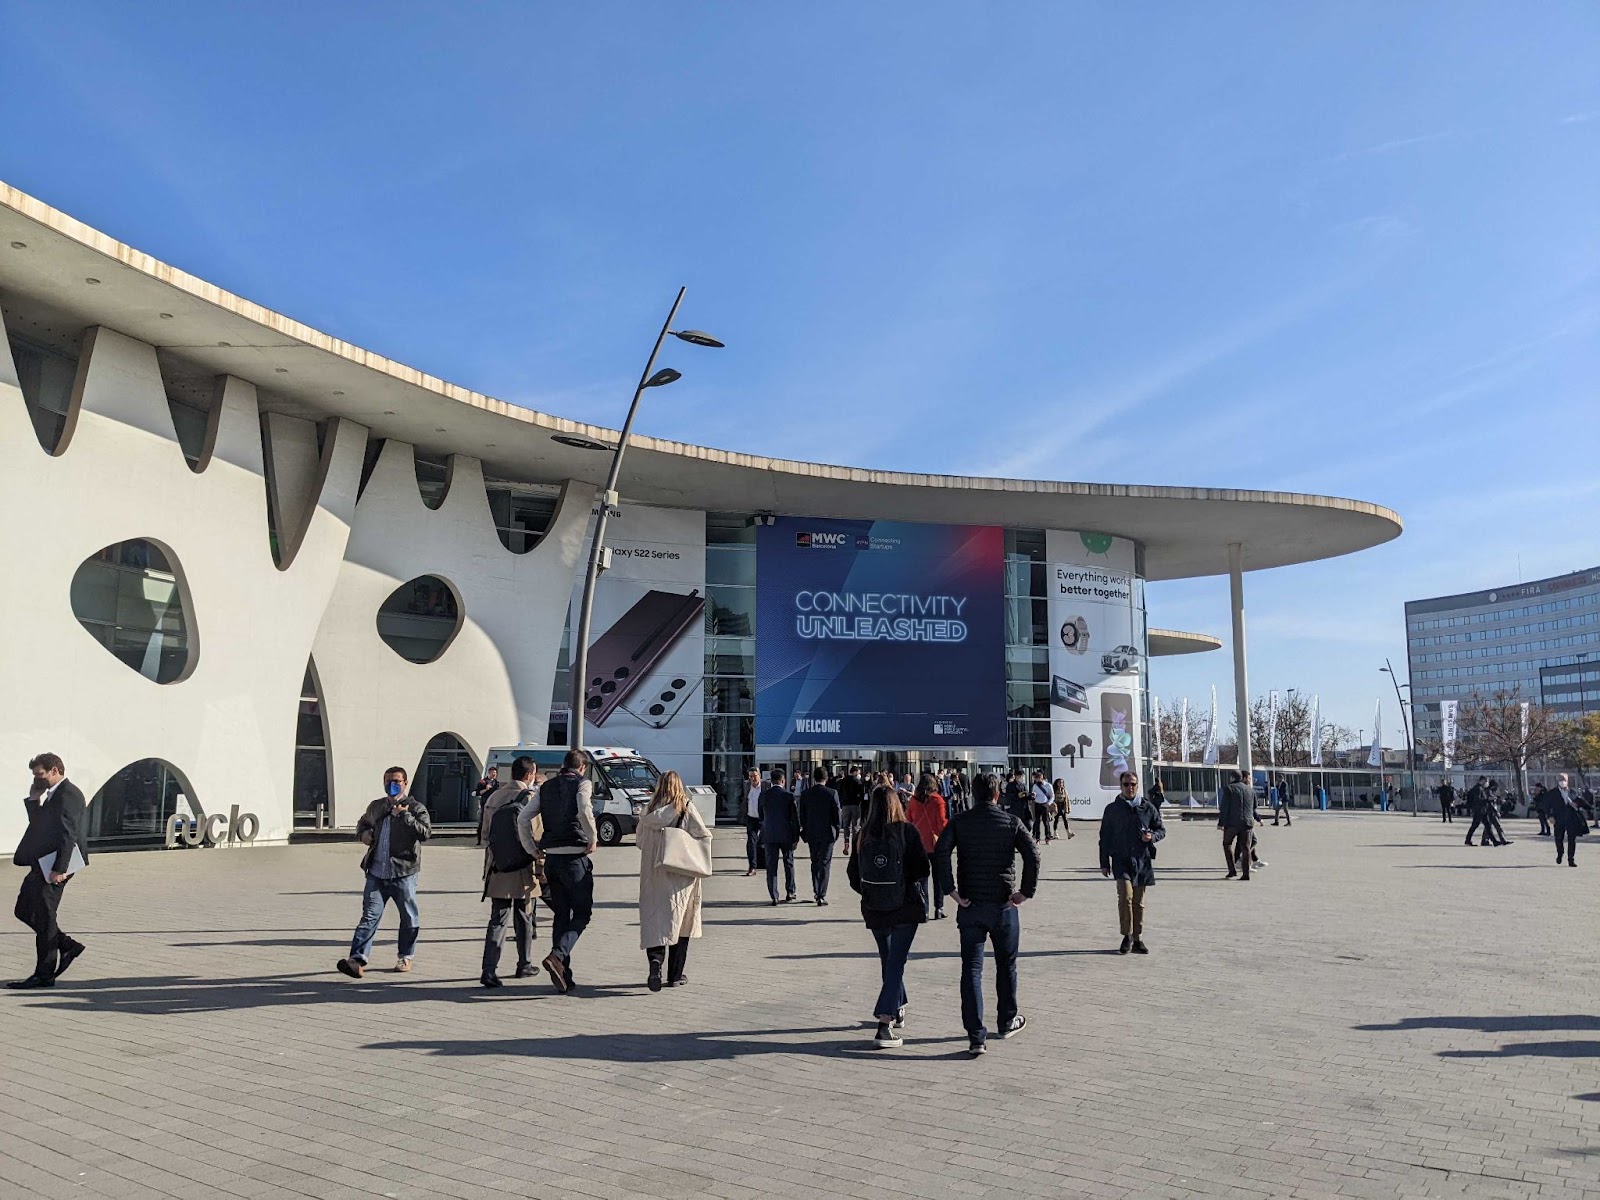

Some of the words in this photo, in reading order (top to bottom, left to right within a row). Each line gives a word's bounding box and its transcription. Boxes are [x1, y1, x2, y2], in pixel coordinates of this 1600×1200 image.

[812, 533, 846, 545] MWC
[869, 537, 901, 545] Connecting
[634, 549, 650, 558] S22
[651, 550, 680, 560] Series
[1057, 569, 1109, 585] Everything
[1110, 576, 1131, 586] works
[1060, 583, 1092, 595] better
[1094, 587, 1129, 599] together
[1521, 586, 1541, 595] FIRA
[796, 591, 967, 616] CONNECTIVITY
[797, 615, 968, 642] UNLEASHED
[795, 719, 841, 733] WELCOME
